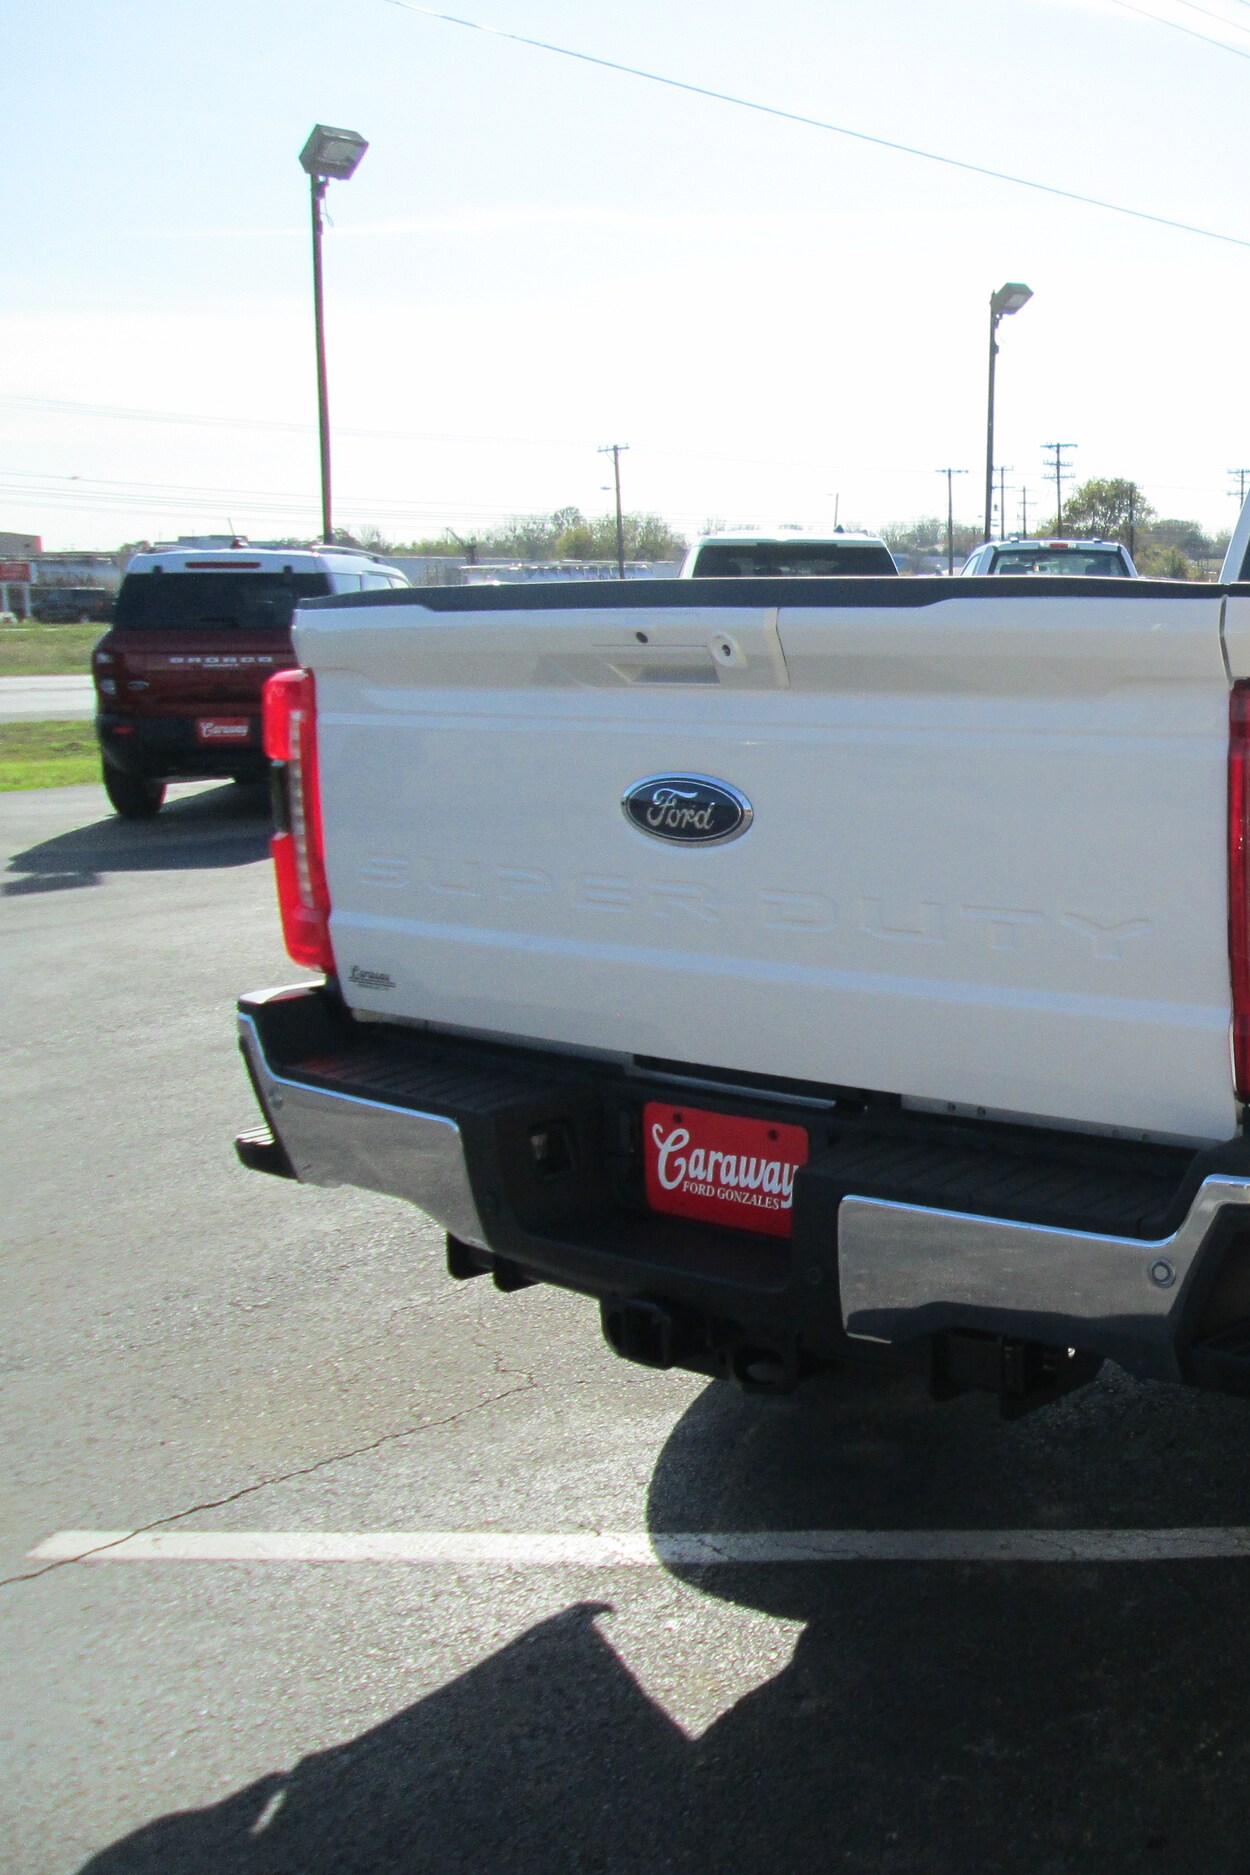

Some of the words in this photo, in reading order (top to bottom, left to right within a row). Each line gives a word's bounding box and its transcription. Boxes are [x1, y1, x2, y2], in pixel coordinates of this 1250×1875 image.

[170, 656, 272, 664] BRONCO
[646, 788, 715, 830] Ford
[360, 853, 720, 923] SUPER
[760, 888, 1153, 960] DUTY
[652, 1123, 799, 1209] Caraway
[682, 1181, 715, 1197] FORD
[717, 1186, 779, 1210] GONZALES
